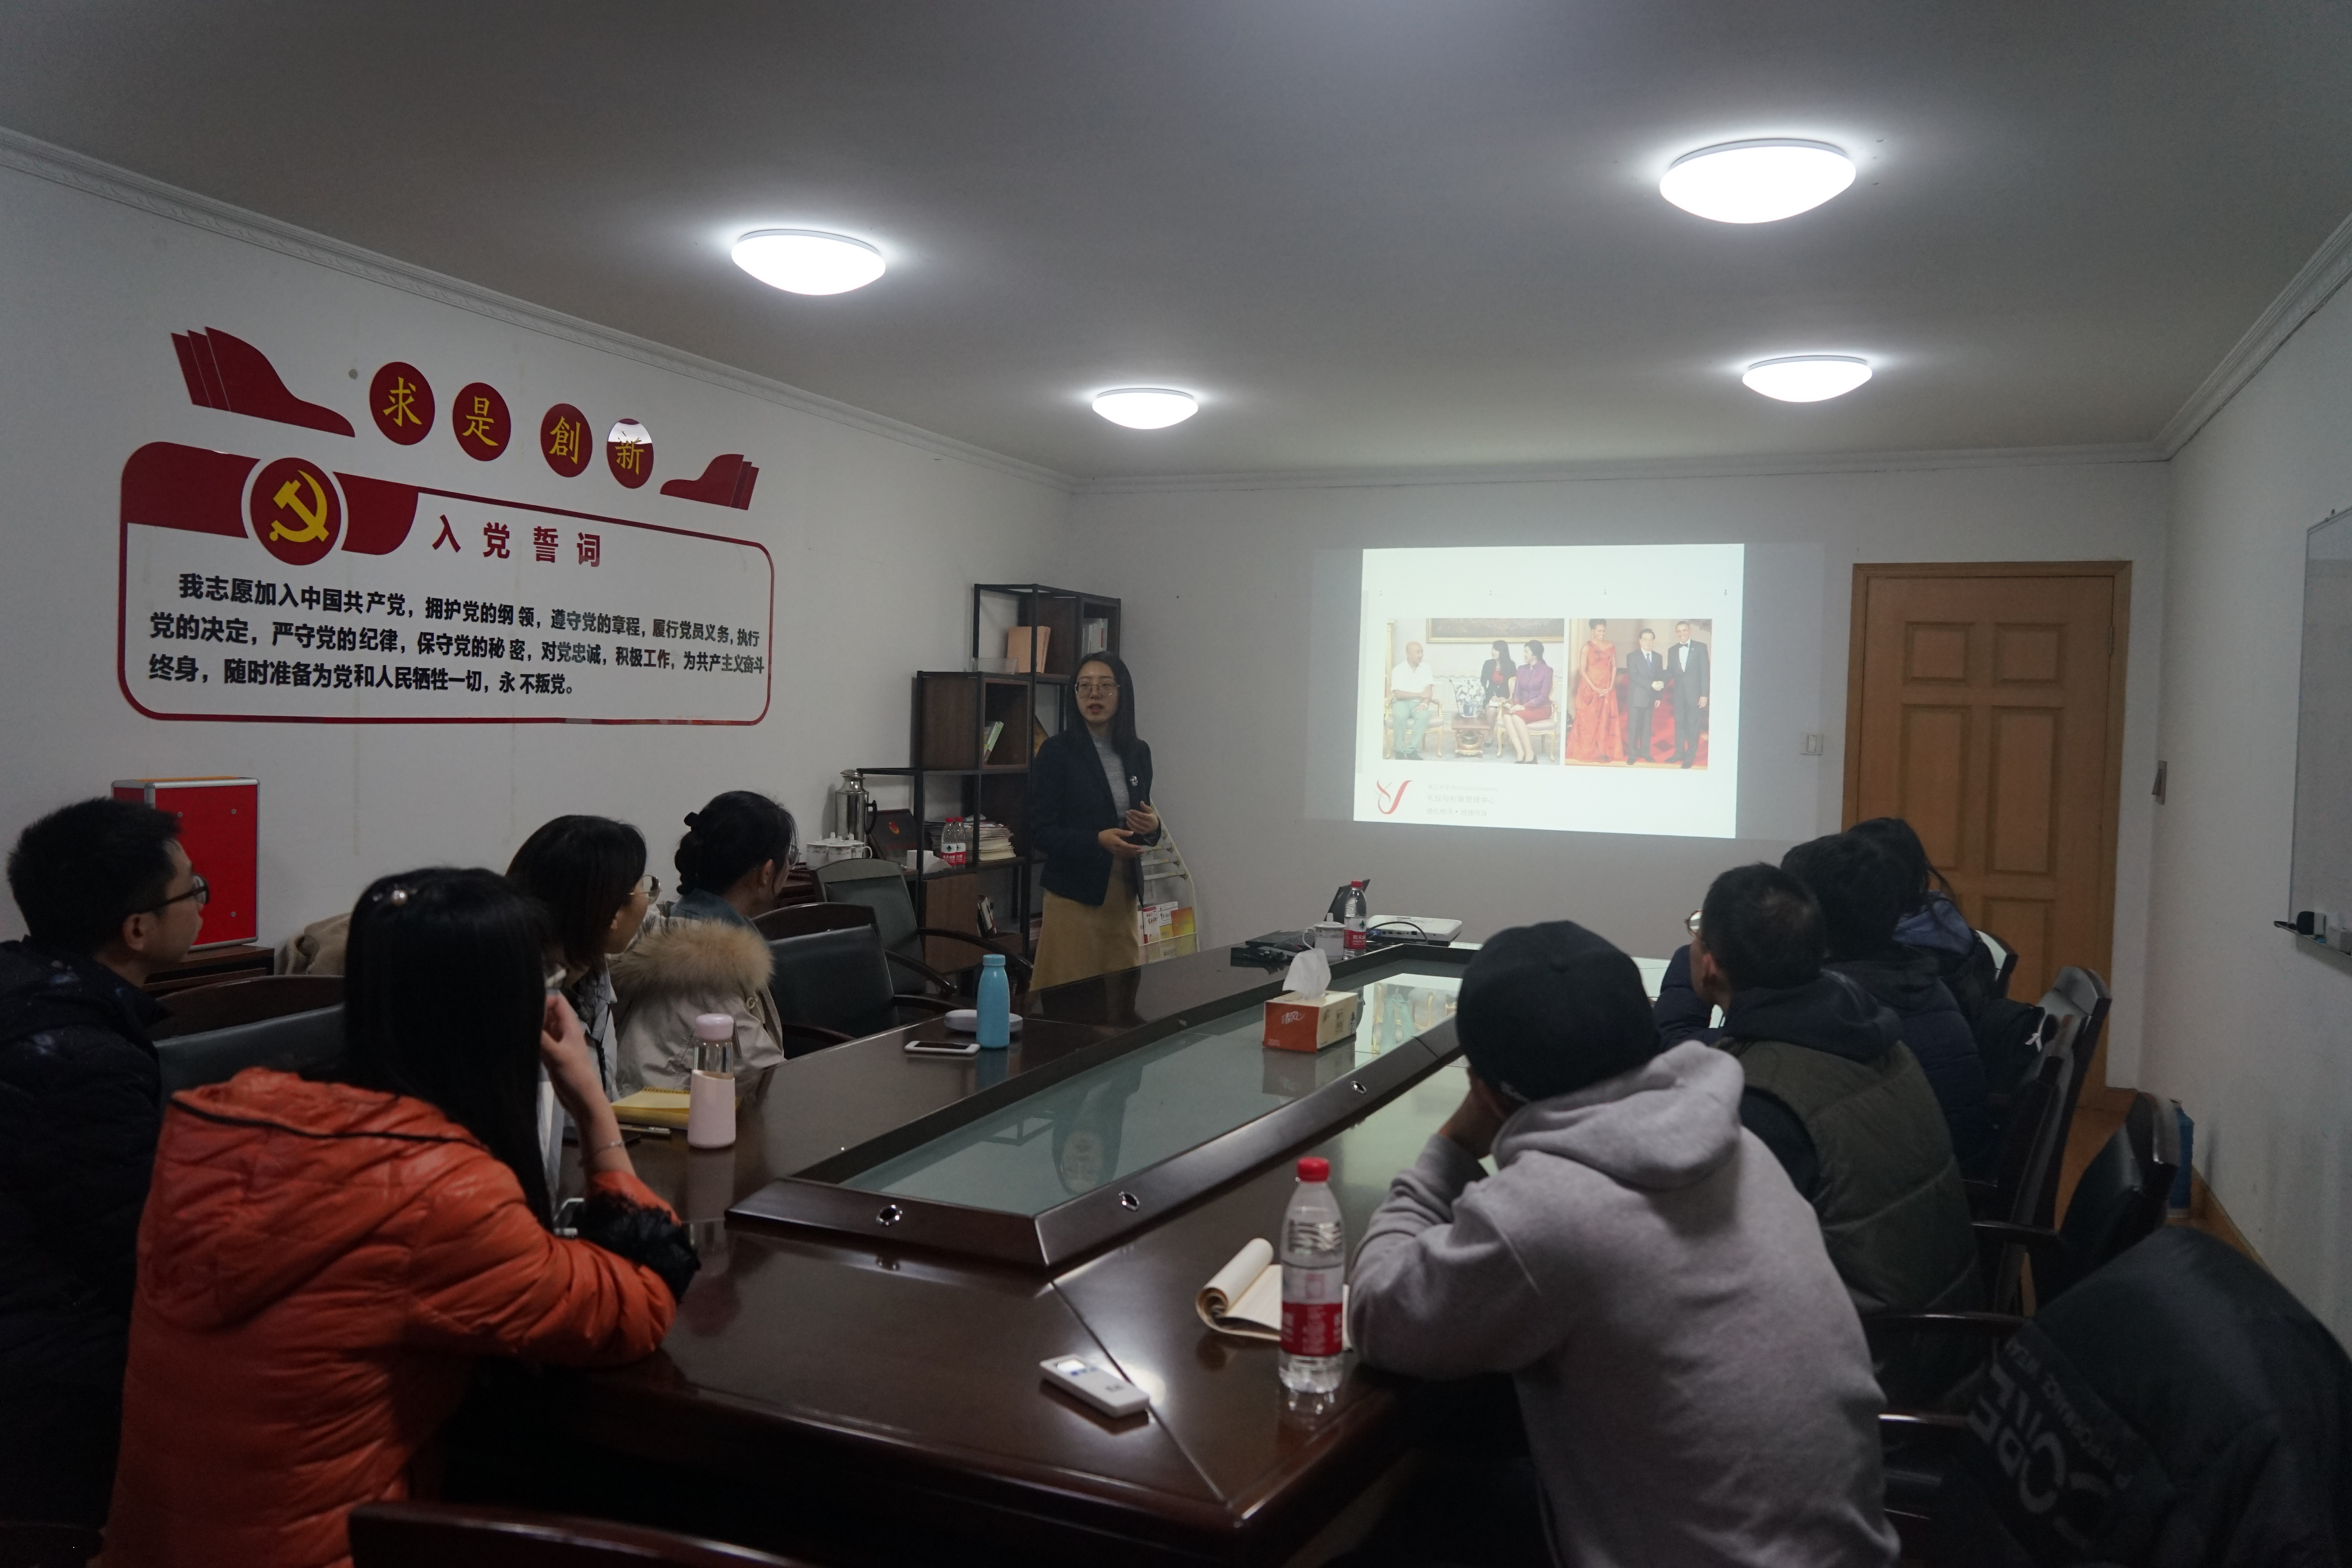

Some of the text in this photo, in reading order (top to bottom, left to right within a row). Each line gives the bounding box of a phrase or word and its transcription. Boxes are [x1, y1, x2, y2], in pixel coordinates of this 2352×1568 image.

[383, 376, 644, 475] 求是創新
[432, 514, 601, 568] 入党誓词
[147, 653, 573, 695] 终身，随时准备为党和人民牺牲一切，永不叛党。
[1427, 794, 1496, 804] 礼仪与形象管理中心
